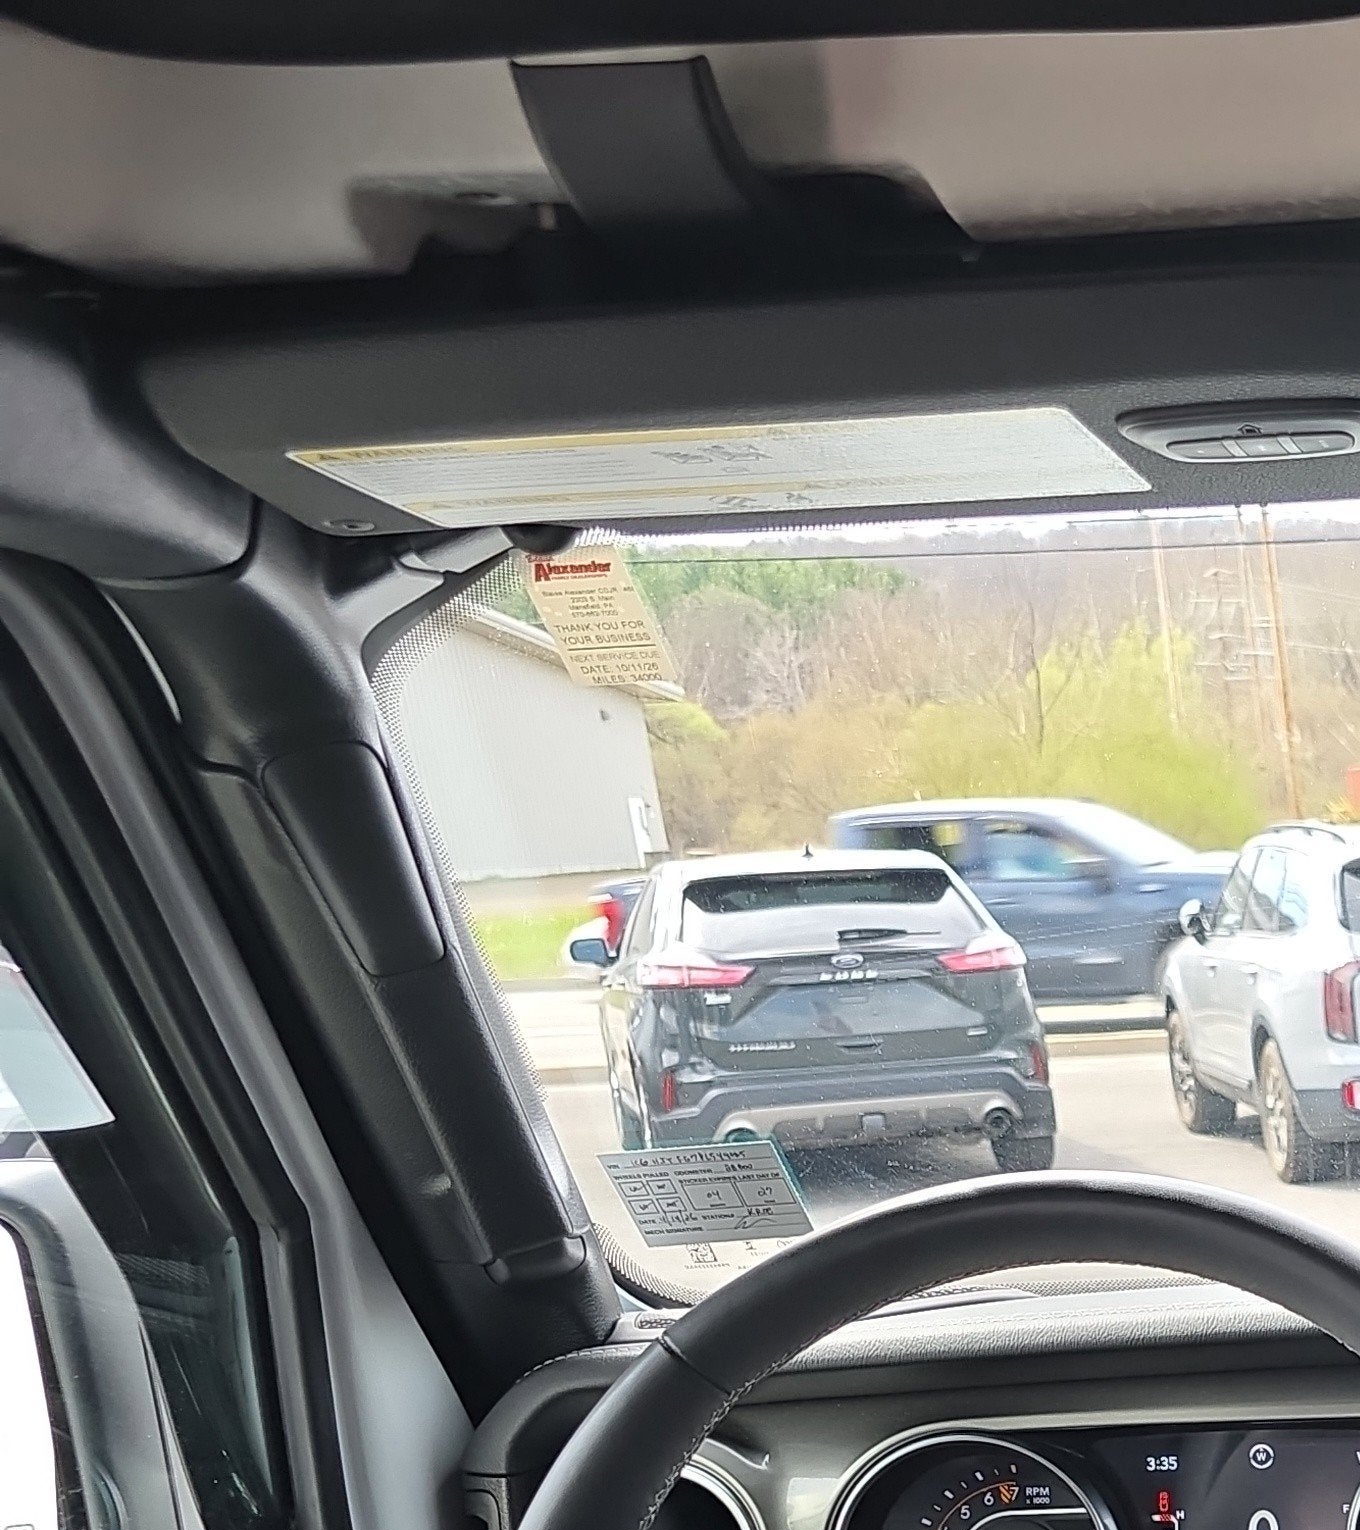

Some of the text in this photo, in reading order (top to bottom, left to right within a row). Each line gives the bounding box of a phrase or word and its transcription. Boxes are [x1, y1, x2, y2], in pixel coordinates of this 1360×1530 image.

[534, 560, 612, 583] Alexander
[554, 620, 646, 633] THANK YOU FOR
[560, 632, 651, 645] YOUR BUSINESS
[570, 651, 661, 663] NEXT SERVICE DUE
[580, 665, 614, 675] DATE:
[1146, 1456, 1178, 1471] 3:35
[1009, 1487, 1019, 1500] 7
[1025, 1487, 1050, 1497] RPM
[984, 1492, 994, 1506] 6
[960, 1505, 971, 1520] 5
[1176, 1510, 1185, 1520] H
[1342, 1504, 1350, 1514] F
